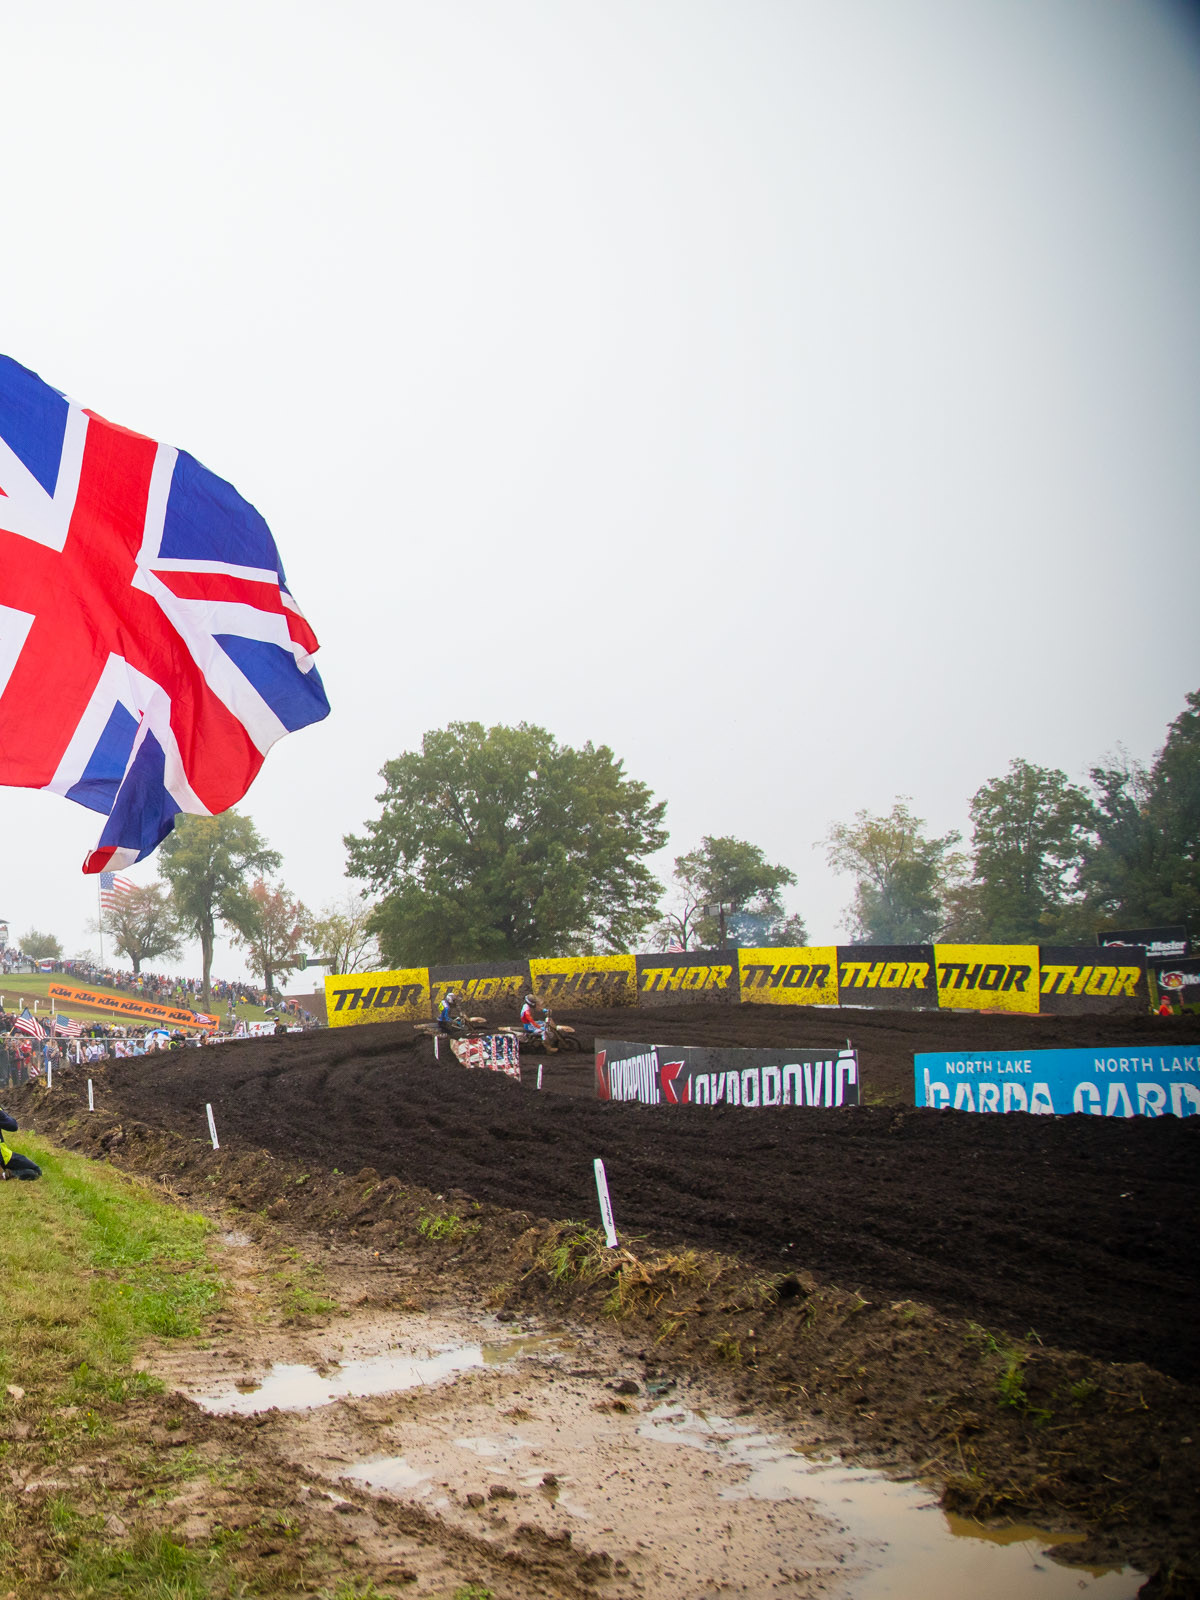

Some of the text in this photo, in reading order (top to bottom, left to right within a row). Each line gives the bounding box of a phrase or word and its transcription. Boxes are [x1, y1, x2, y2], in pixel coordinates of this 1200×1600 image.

[641, 965, 733, 991] THOR
[742, 964, 831, 988] THOR
[840, 962, 930, 988] THOR
[938, 963, 1032, 992] THOR
[1040, 965, 1141, 996] THOR
[332, 984, 425, 1011] THOR
[431, 976, 525, 1004] THOR
[51, 987, 72, 997] KTM
[74, 992, 96, 1002] KTM
[98, 997, 119, 1007] KTM
[121, 1002, 143, 1012] KTM
[144, 1007, 166, 1017] KTM
[168, 1012, 191, 1022] KTM
[946, 1060, 1032, 1074] NORTH LAKE
[1094, 1058, 1154, 1072] NORTH
[928, 1081, 1055, 1115] GARDA
